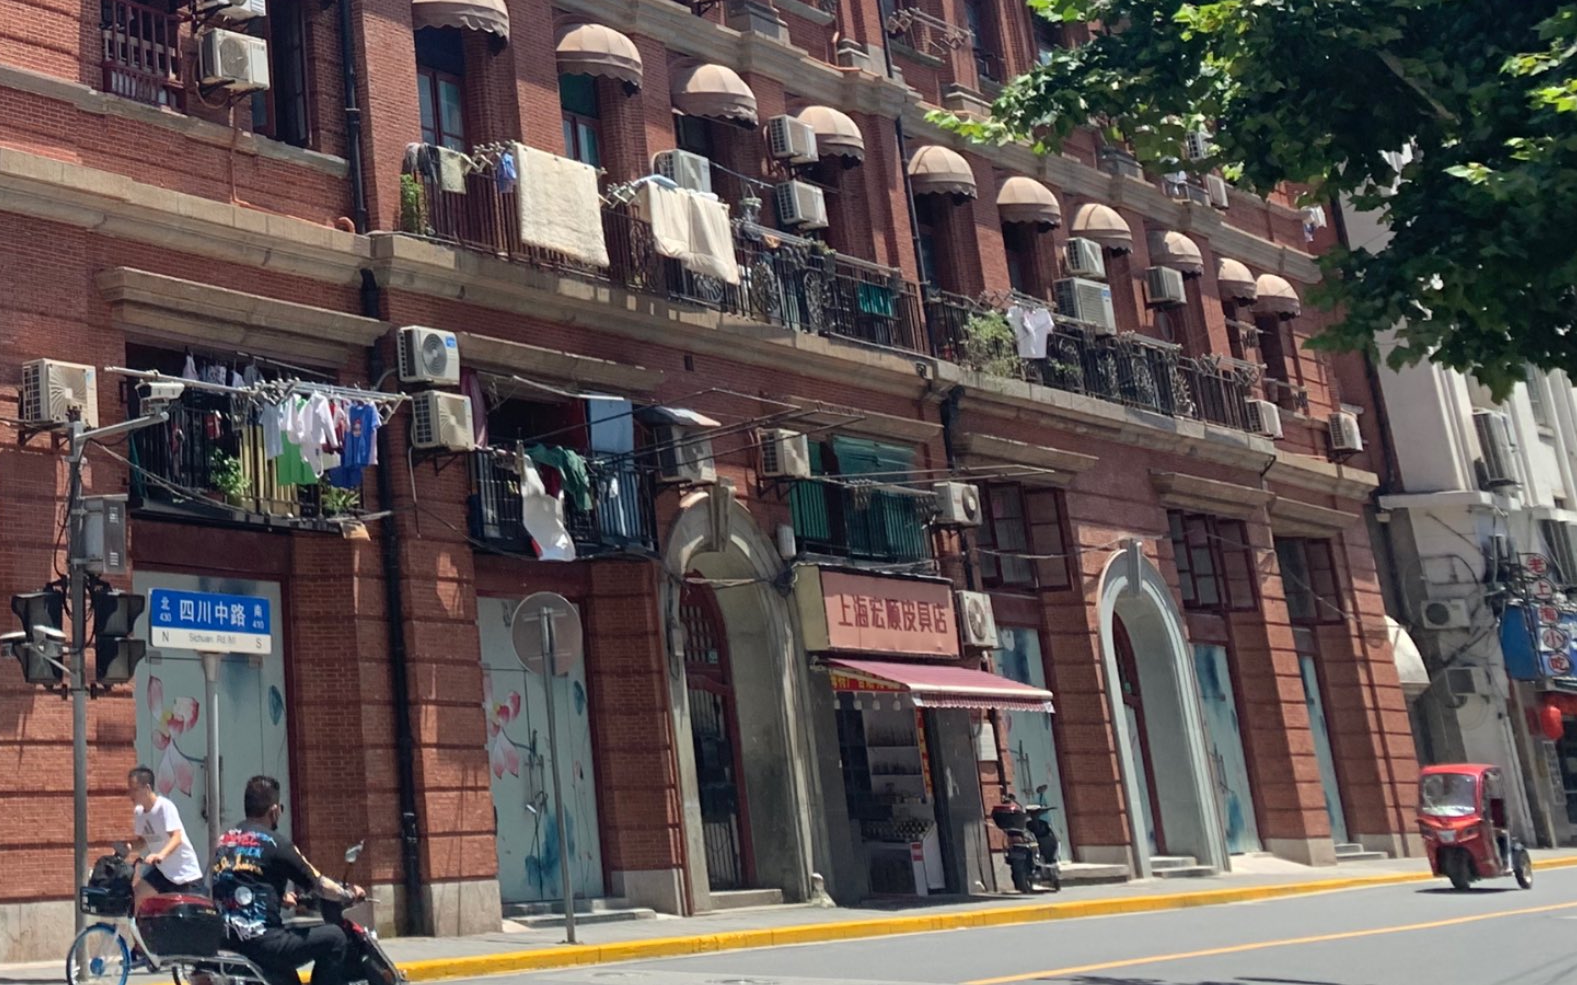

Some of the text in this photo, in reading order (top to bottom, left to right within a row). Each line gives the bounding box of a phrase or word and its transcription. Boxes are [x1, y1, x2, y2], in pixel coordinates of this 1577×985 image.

[160, 596, 170, 611] 北
[179, 599, 246, 627] 四川中路
[253, 604, 263, 618] 南
[161, 631, 169, 642] N
[255, 637, 263, 649] S
